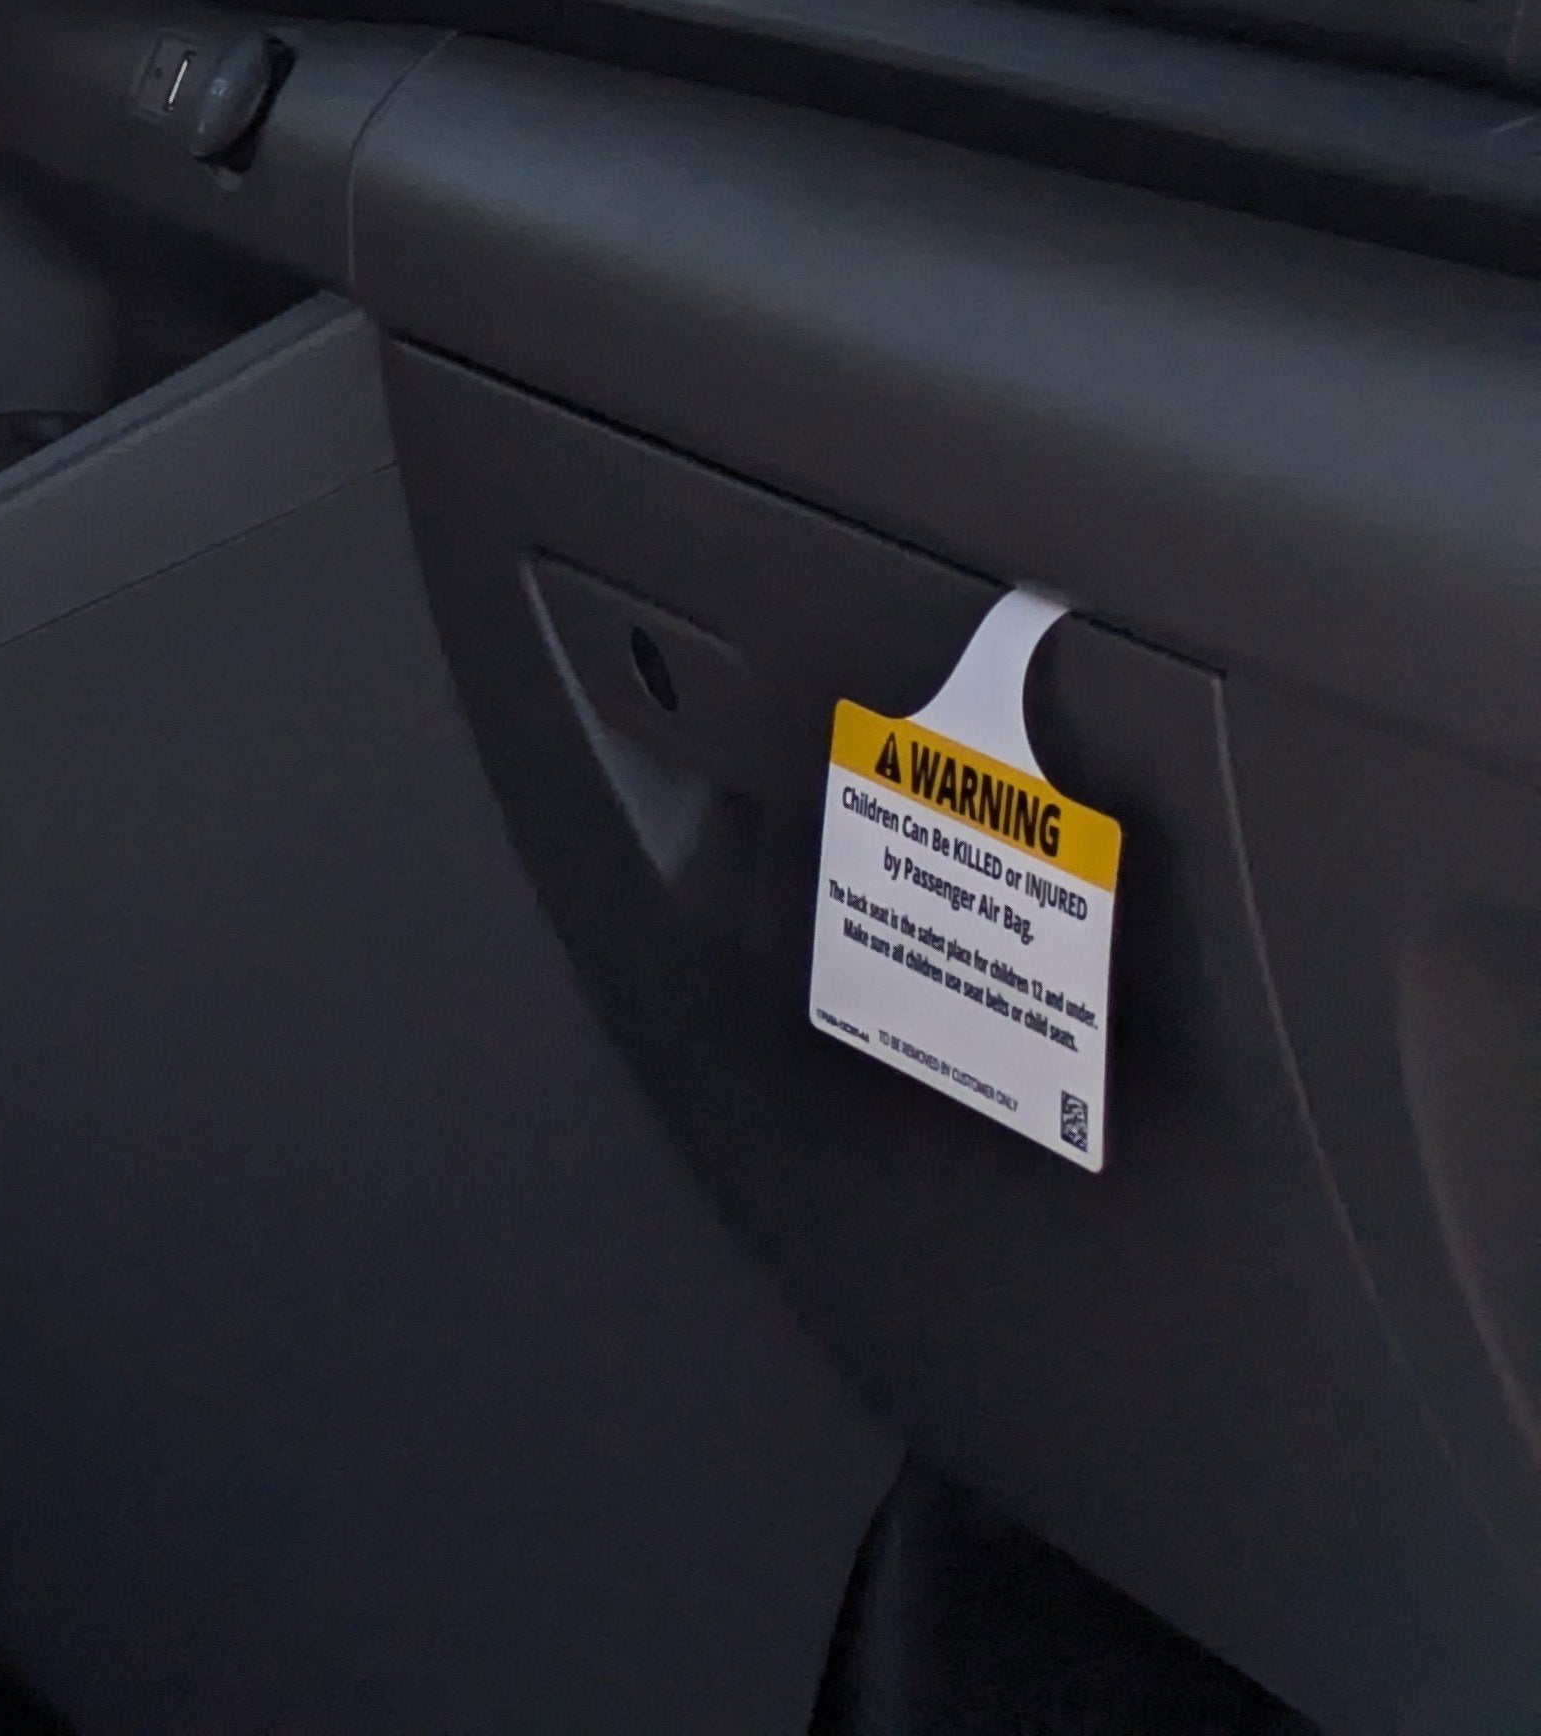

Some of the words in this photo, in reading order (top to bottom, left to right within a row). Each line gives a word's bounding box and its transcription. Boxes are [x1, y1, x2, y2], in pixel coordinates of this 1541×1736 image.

[842, 786, 899, 833] Children
[902, 815, 929, 847] Can
[931, 828, 950, 857] Be
[953, 837, 1003, 880] KILLED
[1005, 868, 1022, 890] or
[1025, 871, 1088, 921] INJURED
[910, 740, 1062, 858] WARNING
[883, 846, 901, 881] by
[904, 857, 976, 912] Passenger
[978, 894, 1000, 923] Air
[829, 878, 845, 904] The
[847, 886, 867, 915] back
[870, 902, 889, 926] seat
[891, 908, 899, 930] is
[900, 914, 916, 939] the
[947, 938, 972, 967] place
[974, 949, 988, 974] for
[990, 959, 1028, 995] children
[1032, 979, 1043, 1002] 12
[1045, 990, 1064, 1012] and
[843, 917, 869, 947] Make
[905, 950, 943, 984] children
[1024, 1009, 1048, 1037] child
